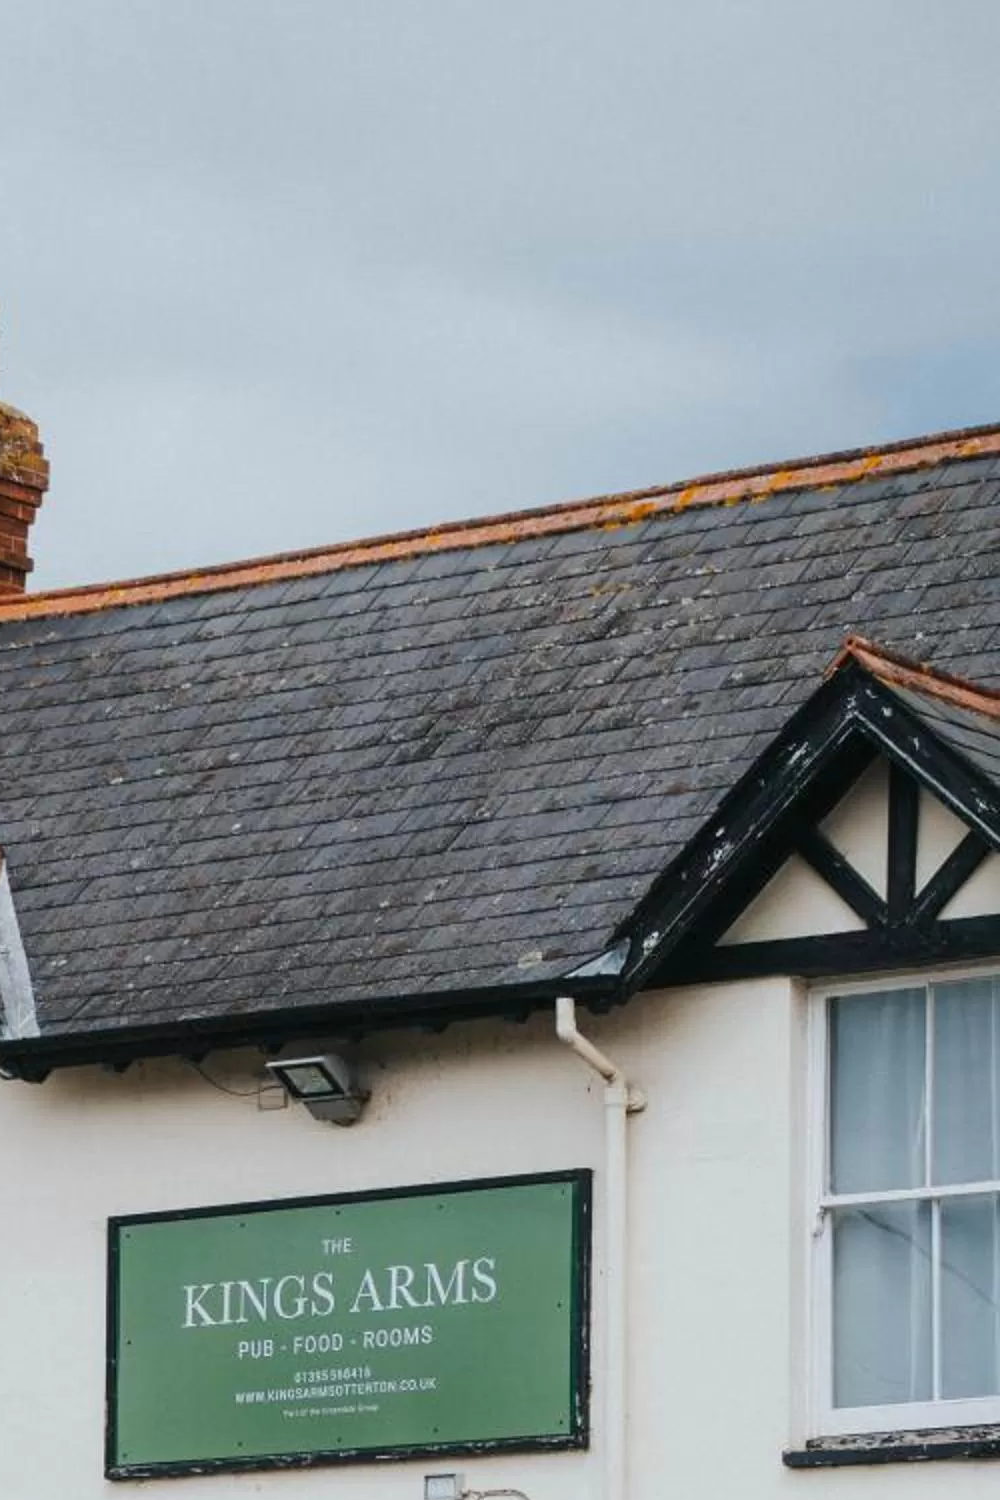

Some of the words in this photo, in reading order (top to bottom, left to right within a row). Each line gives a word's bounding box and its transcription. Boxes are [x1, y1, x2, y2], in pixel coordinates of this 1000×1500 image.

[321, 1237, 353, 1256] THE
[181, 1271, 335, 1329] KINGS
[349, 1256, 498, 1314] ARMS
[238, 1339, 274, 1360] PUB
[293, 1332, 344, 1355] FOOD
[363, 1325, 433, 1349] ROOMS
